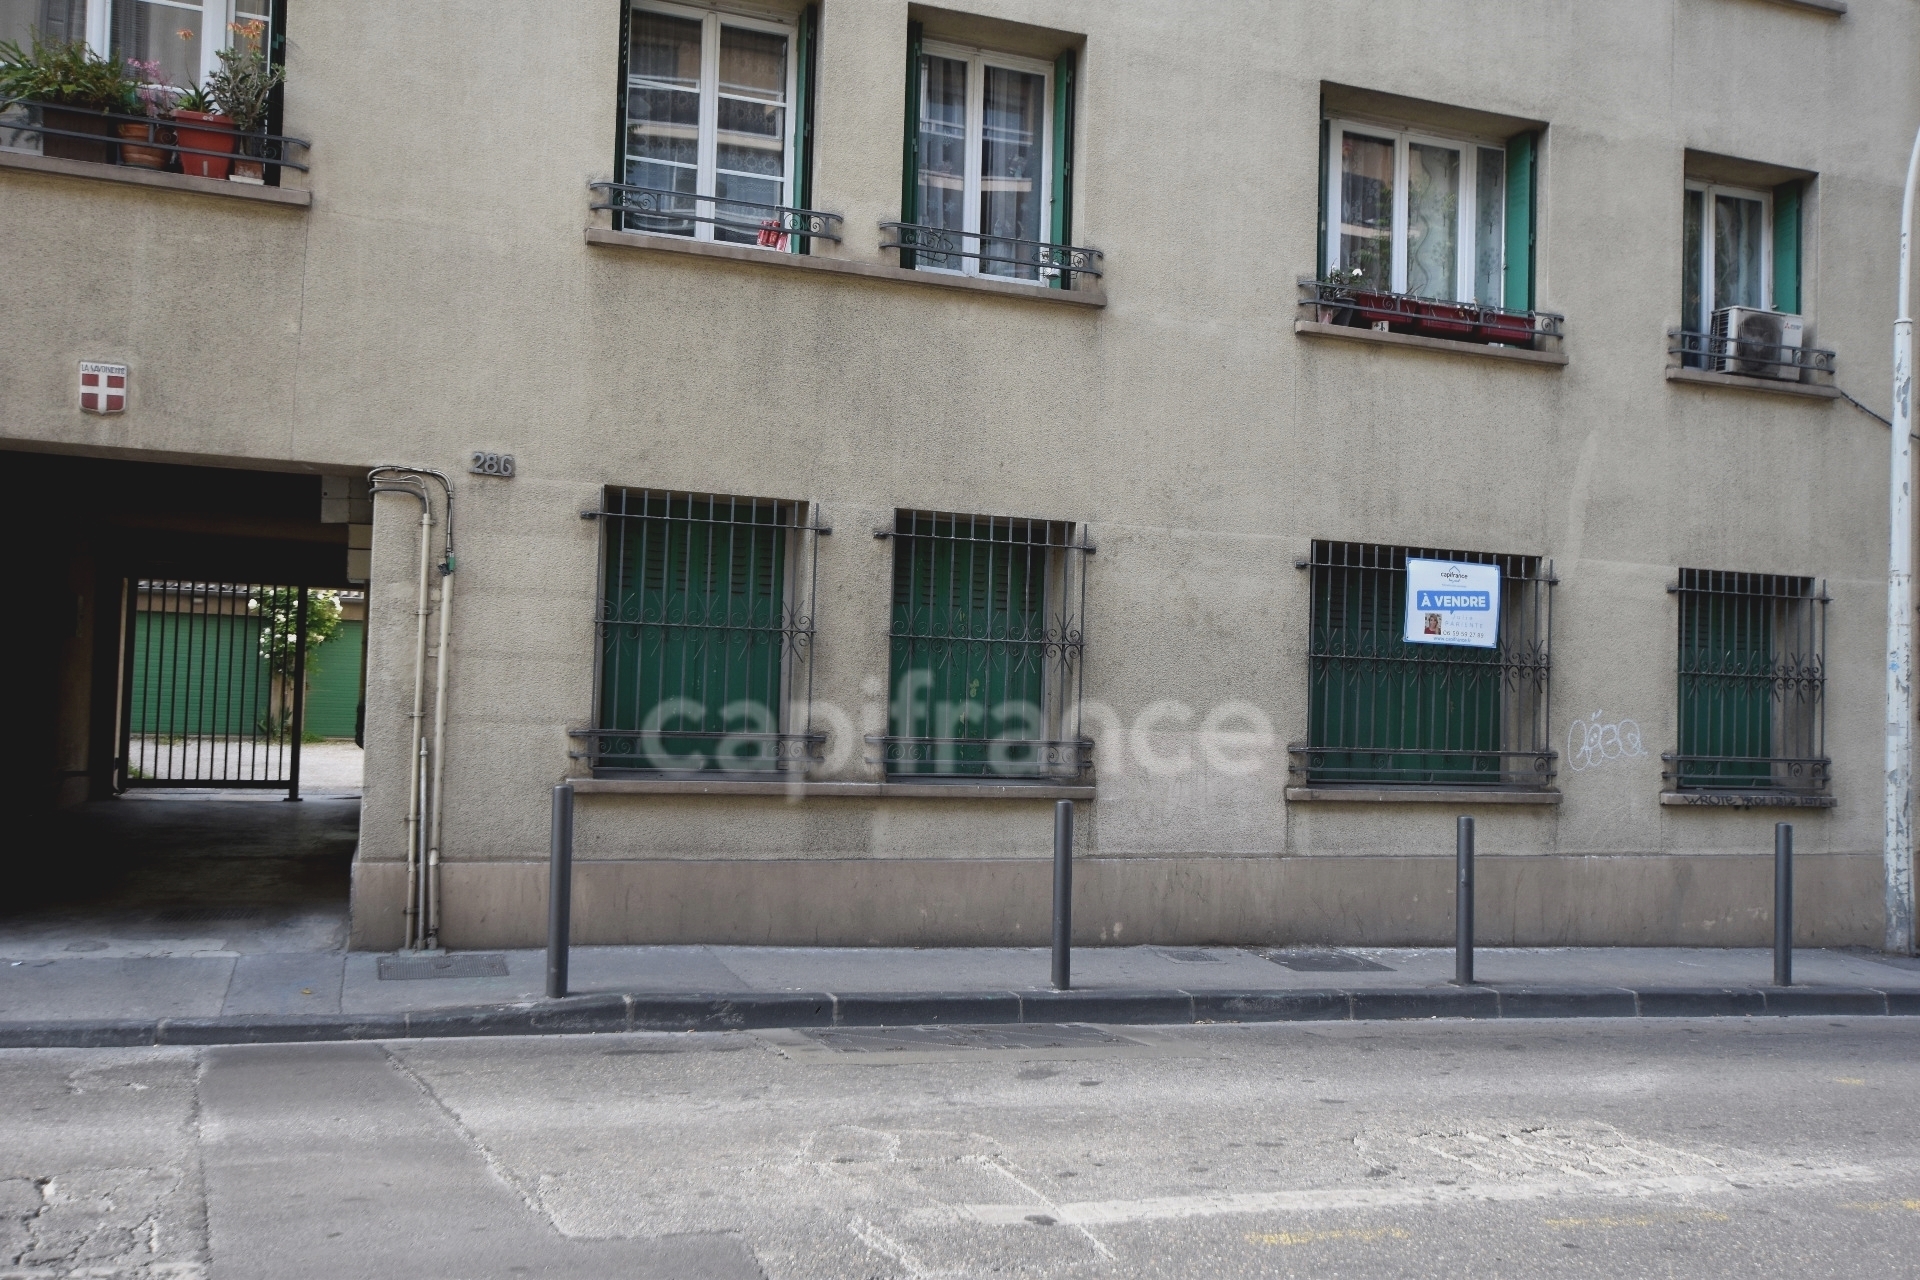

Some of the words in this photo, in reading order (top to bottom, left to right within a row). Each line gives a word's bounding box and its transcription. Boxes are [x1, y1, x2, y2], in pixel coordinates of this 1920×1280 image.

[82, 364, 89, 372] LA
[1420, 593, 1431, 607] À
[1434, 595, 1486, 608] VENDRE
